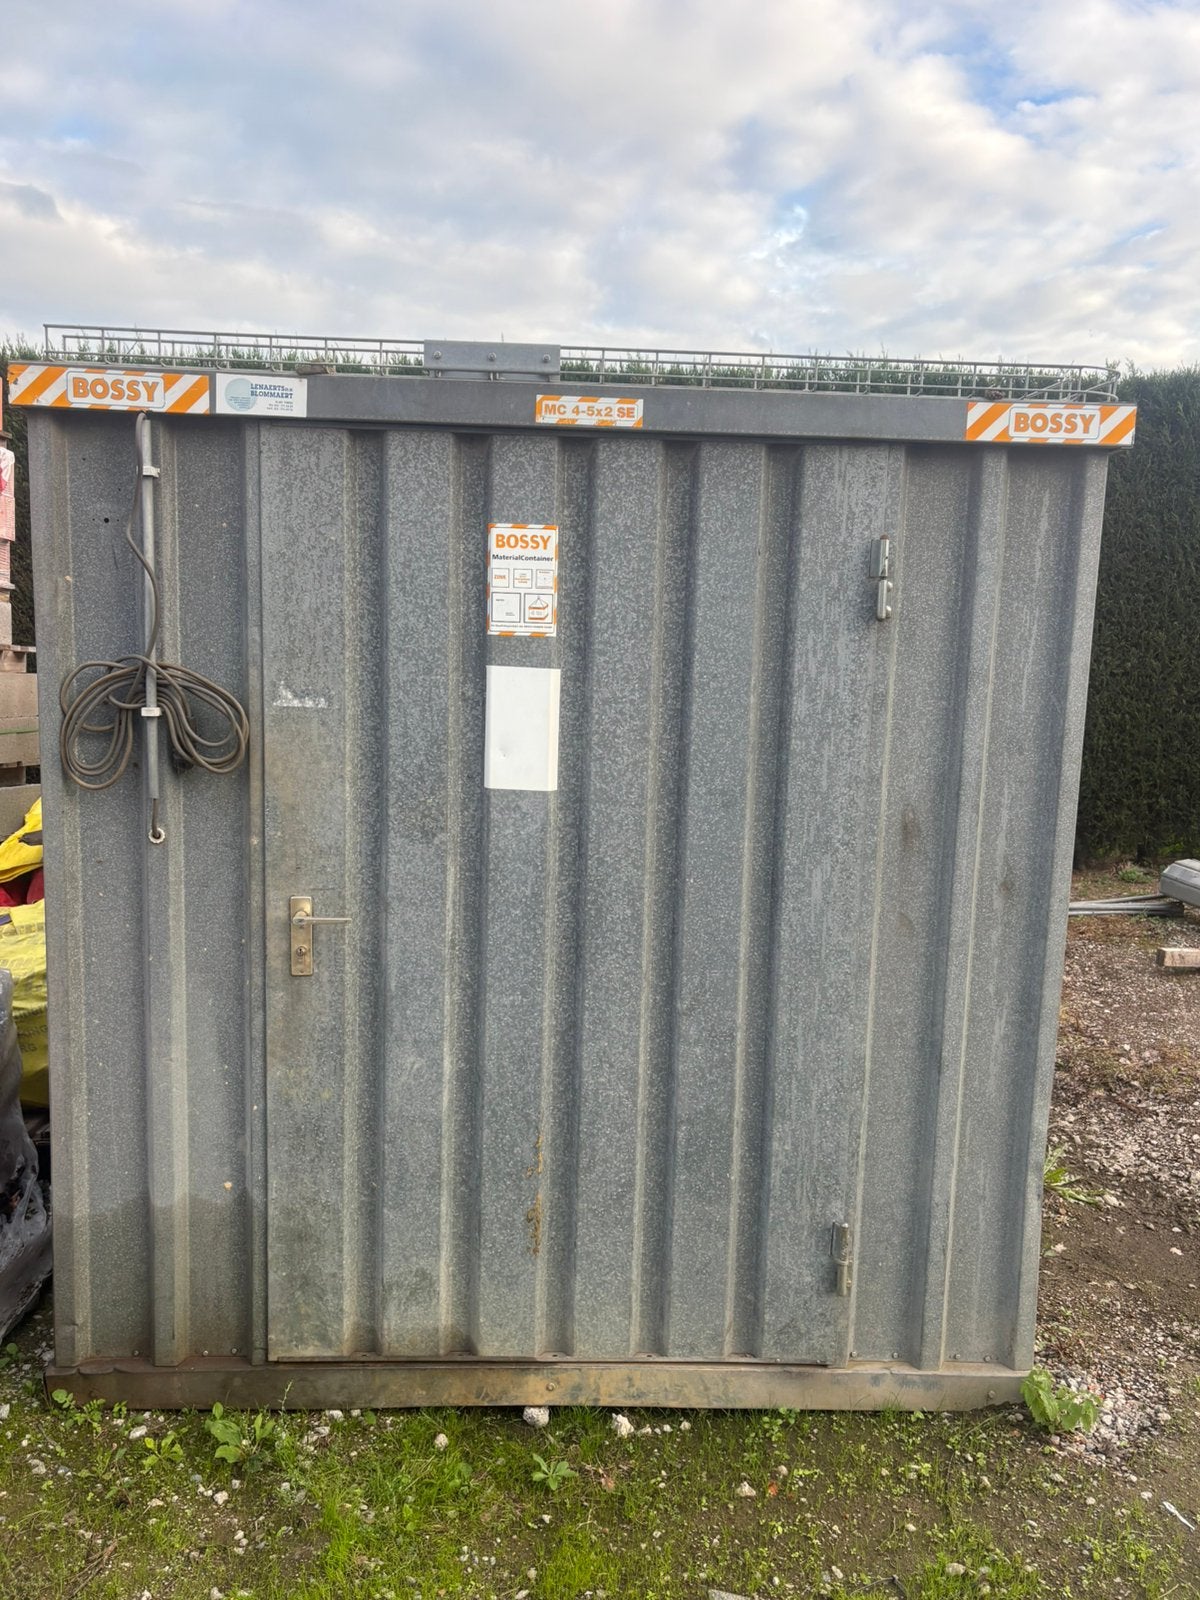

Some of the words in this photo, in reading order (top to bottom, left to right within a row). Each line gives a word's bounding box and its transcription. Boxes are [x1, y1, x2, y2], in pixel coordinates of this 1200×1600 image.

[73, 376, 160, 402] BOSSY
[250, 390, 293, 399] BLOMMAERT
[543, 403, 567, 415] MC
[571, 405, 613, 417] 4-5x2
[617, 407, 636, 418] SE
[1013, 412, 1096, 434] BOSSY
[495, 533, 551, 550] BOSSY
[492, 554, 554, 562] MaterialContainer
